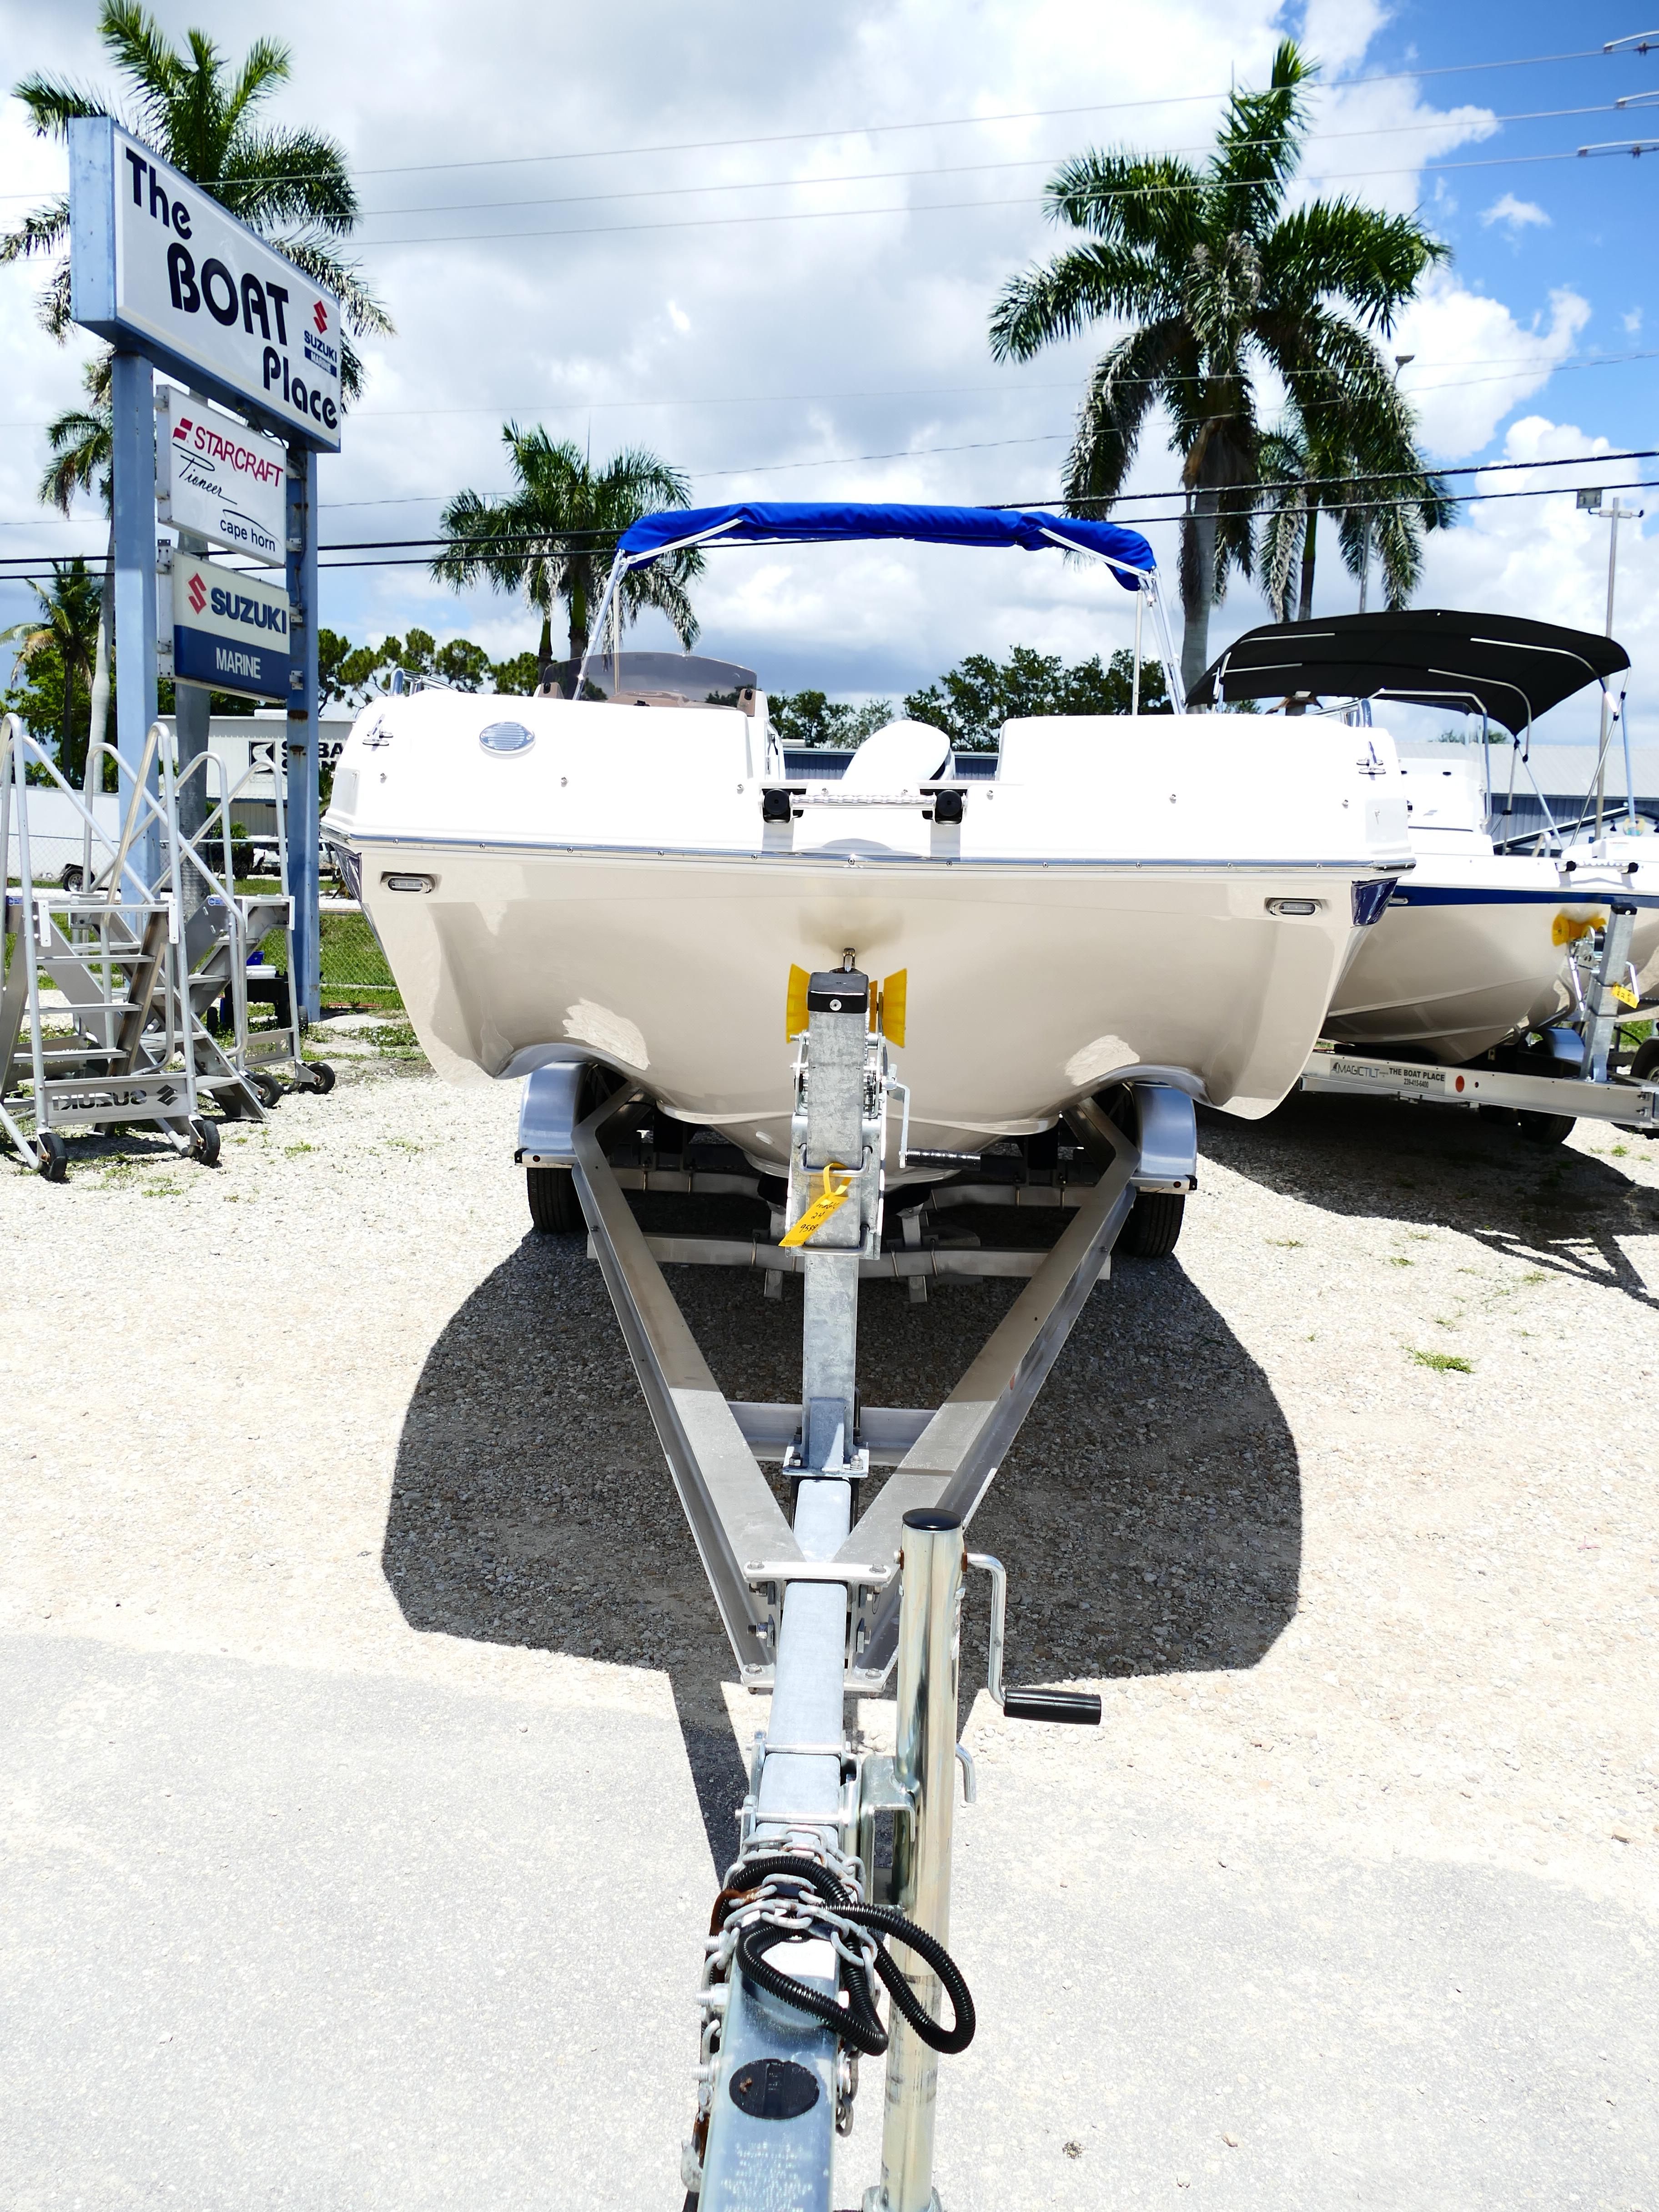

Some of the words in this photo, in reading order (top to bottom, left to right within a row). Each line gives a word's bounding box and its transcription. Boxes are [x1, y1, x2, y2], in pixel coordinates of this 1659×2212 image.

[126, 147, 193, 240] The
[166, 242, 289, 346] BOAT
[304, 330, 337, 363] SUZUKI
[262, 346, 338, 430] Place
[172, 442, 238, 505] Pioneer
[194, 426, 284, 487] STARCRAFT
[220, 518, 247, 540] cape
[251, 528, 276, 552] horn
[211, 587, 287, 634] SUZUKI
[216, 647, 261, 679] MARINE
[1389, 1067, 1402, 1076] THE
[1403, 1069, 1421, 1078] BOAT
[1423, 1071, 1445, 1082] PLACE
